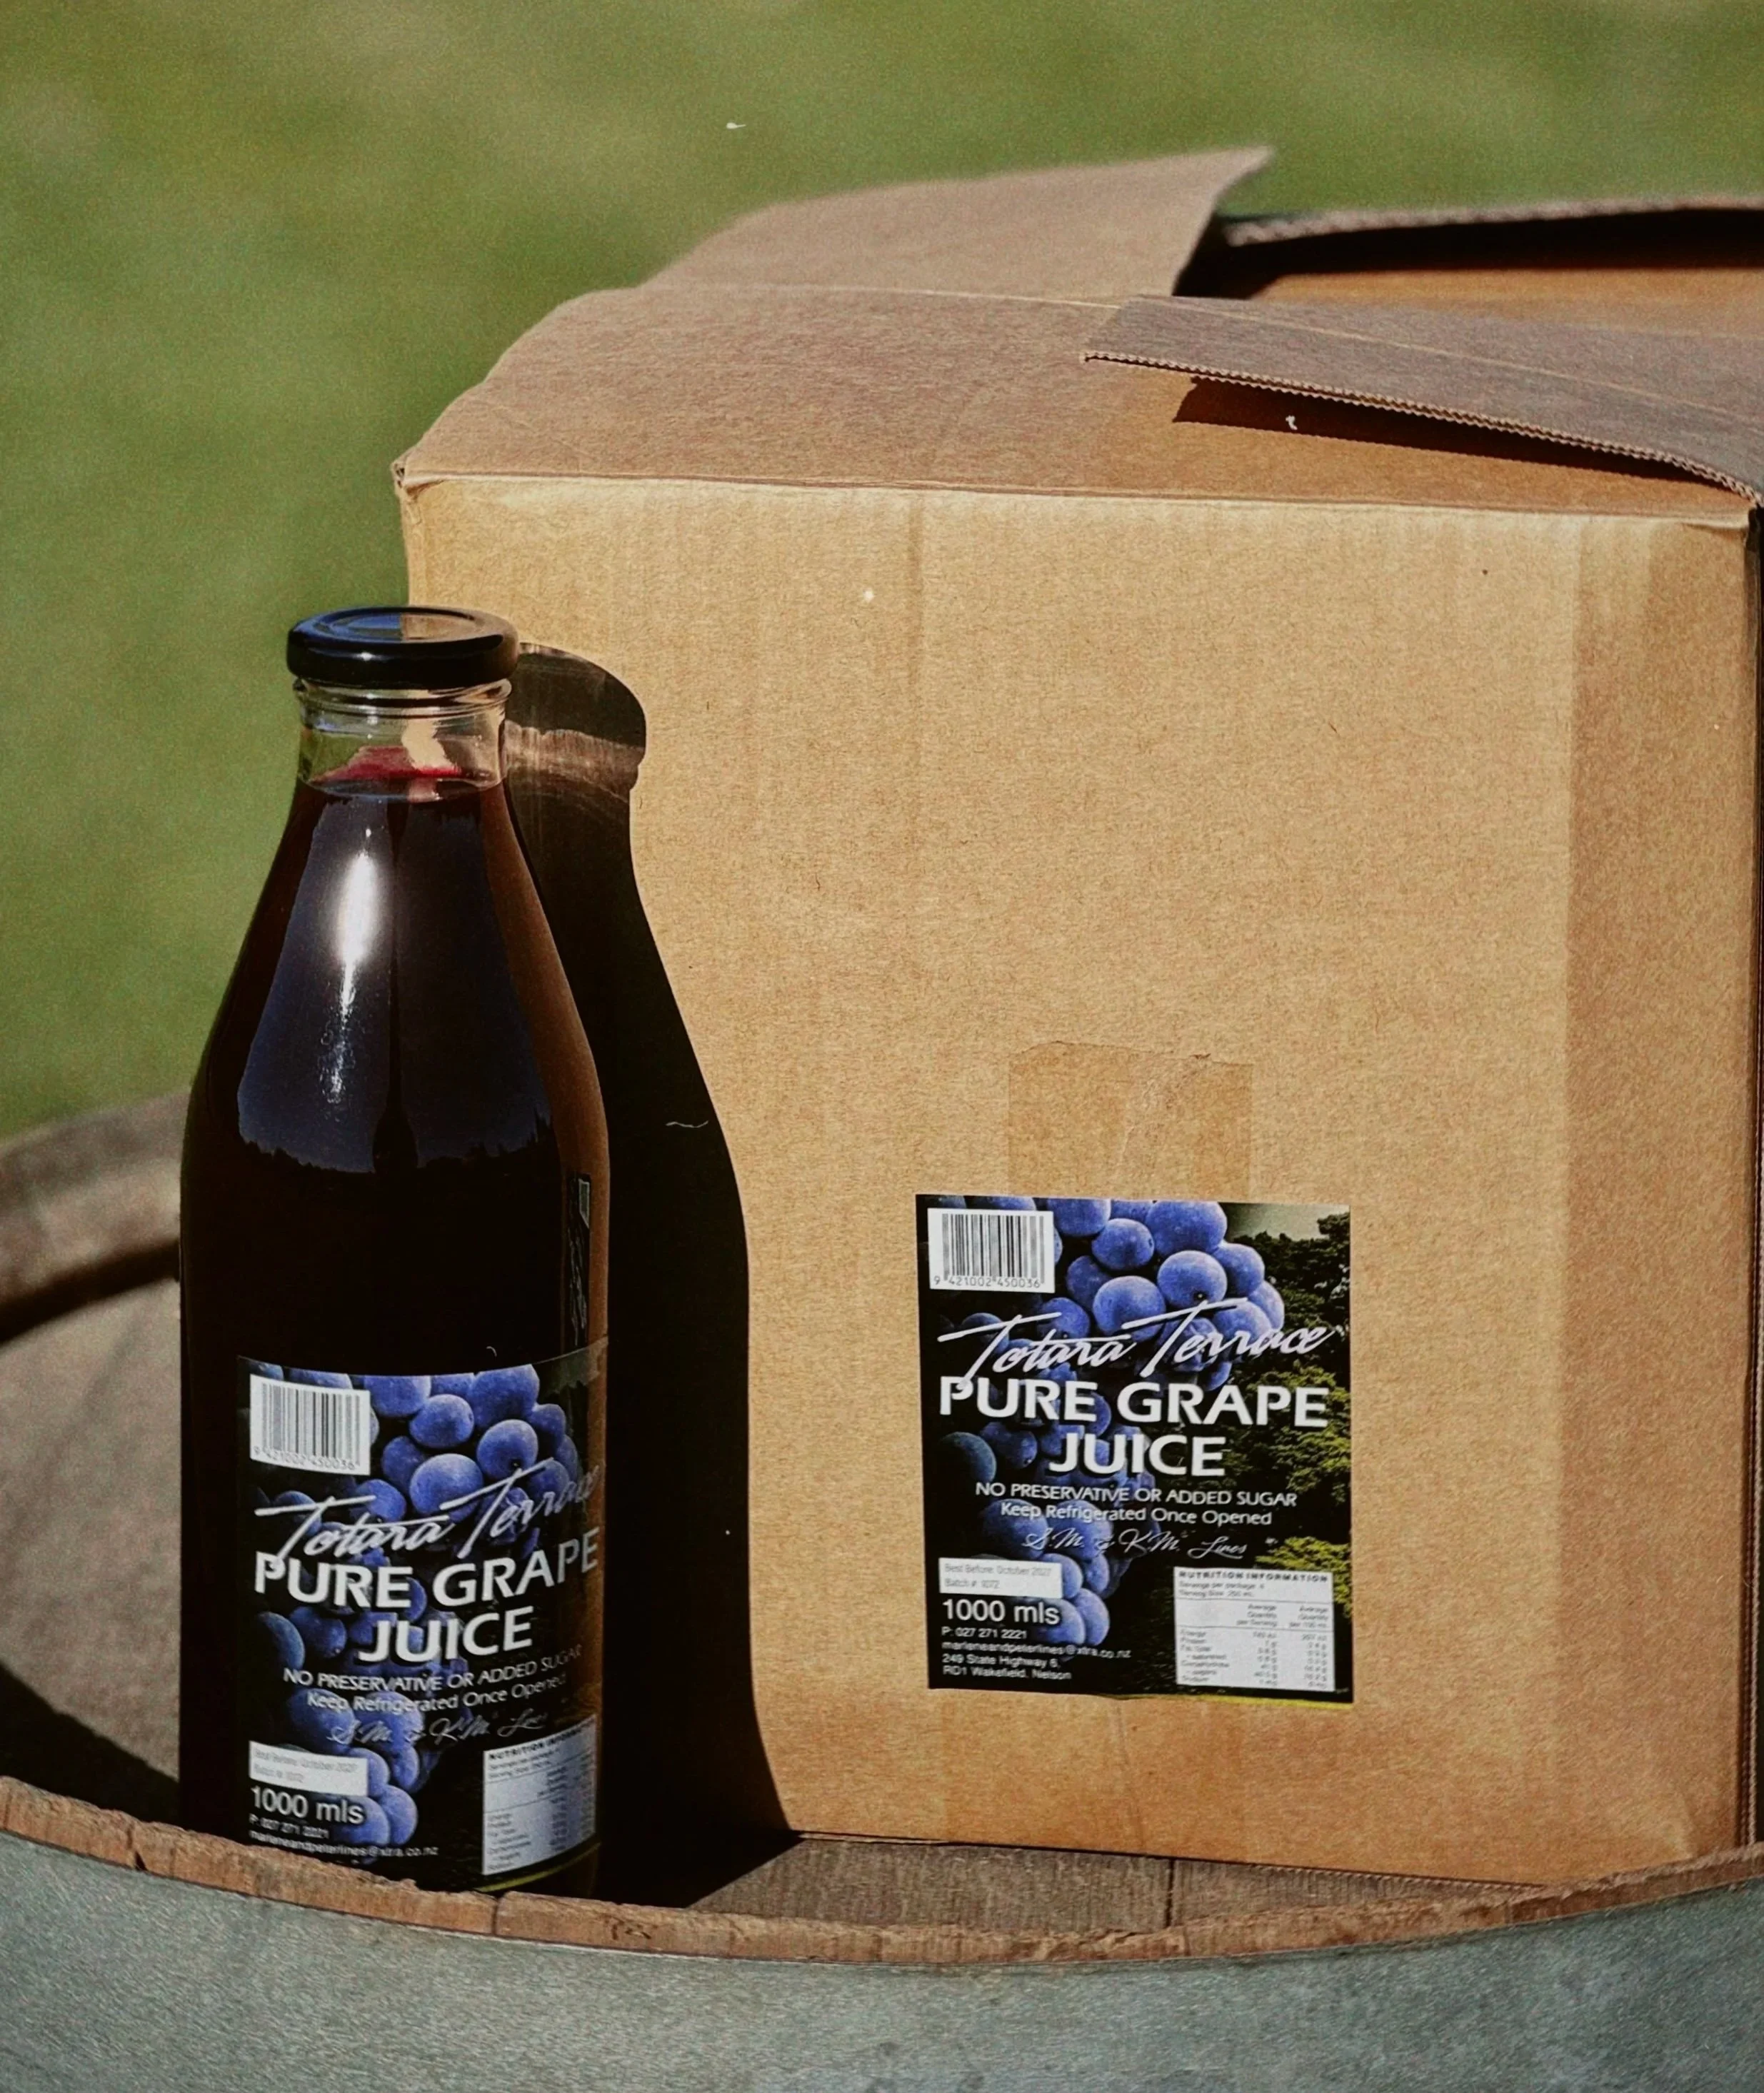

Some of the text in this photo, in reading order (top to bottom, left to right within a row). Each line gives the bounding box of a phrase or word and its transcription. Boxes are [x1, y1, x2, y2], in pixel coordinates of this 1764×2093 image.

[937, 1297, 1335, 1391] Totara Terrace
[940, 1375, 1329, 1427] PURE GRAPE
[1048, 1432, 1226, 1477] JUICE
[976, 1482, 1297, 1507] NO PRESERVATIVE OR ADDED SUGAR
[1001, 1501, 1272, 1527] Keep Refrigerated Once Opened
[255, 1495, 456, 1570] Totara
[255, 1527, 600, 1608] PURE GRAPE
[1179, 1570, 1328, 1582] NUTRITION INFORMATION
[942, 1599, 1061, 1625] 1000 mls
[358, 1606, 533, 1662] JUICE
[955, 1627, 976, 1637] 027
[978, 1628, 998, 1637] 271
[1001, 1630, 1027, 1639] 2221
[284, 1645, 583, 1692] NO PRESERVATIVE OR ADDED SUGAR
[966, 1654, 996, 1665] State
[999, 1655, 1047, 1668] Highway
[1032, 1669, 1071, 1680] Nelson
[307, 1690, 348, 1711] Keep
[353, 1692, 457, 1714] Refrigerated
[463, 1688, 507, 1707] Once
[251, 1786, 365, 1825] 1000 mls
